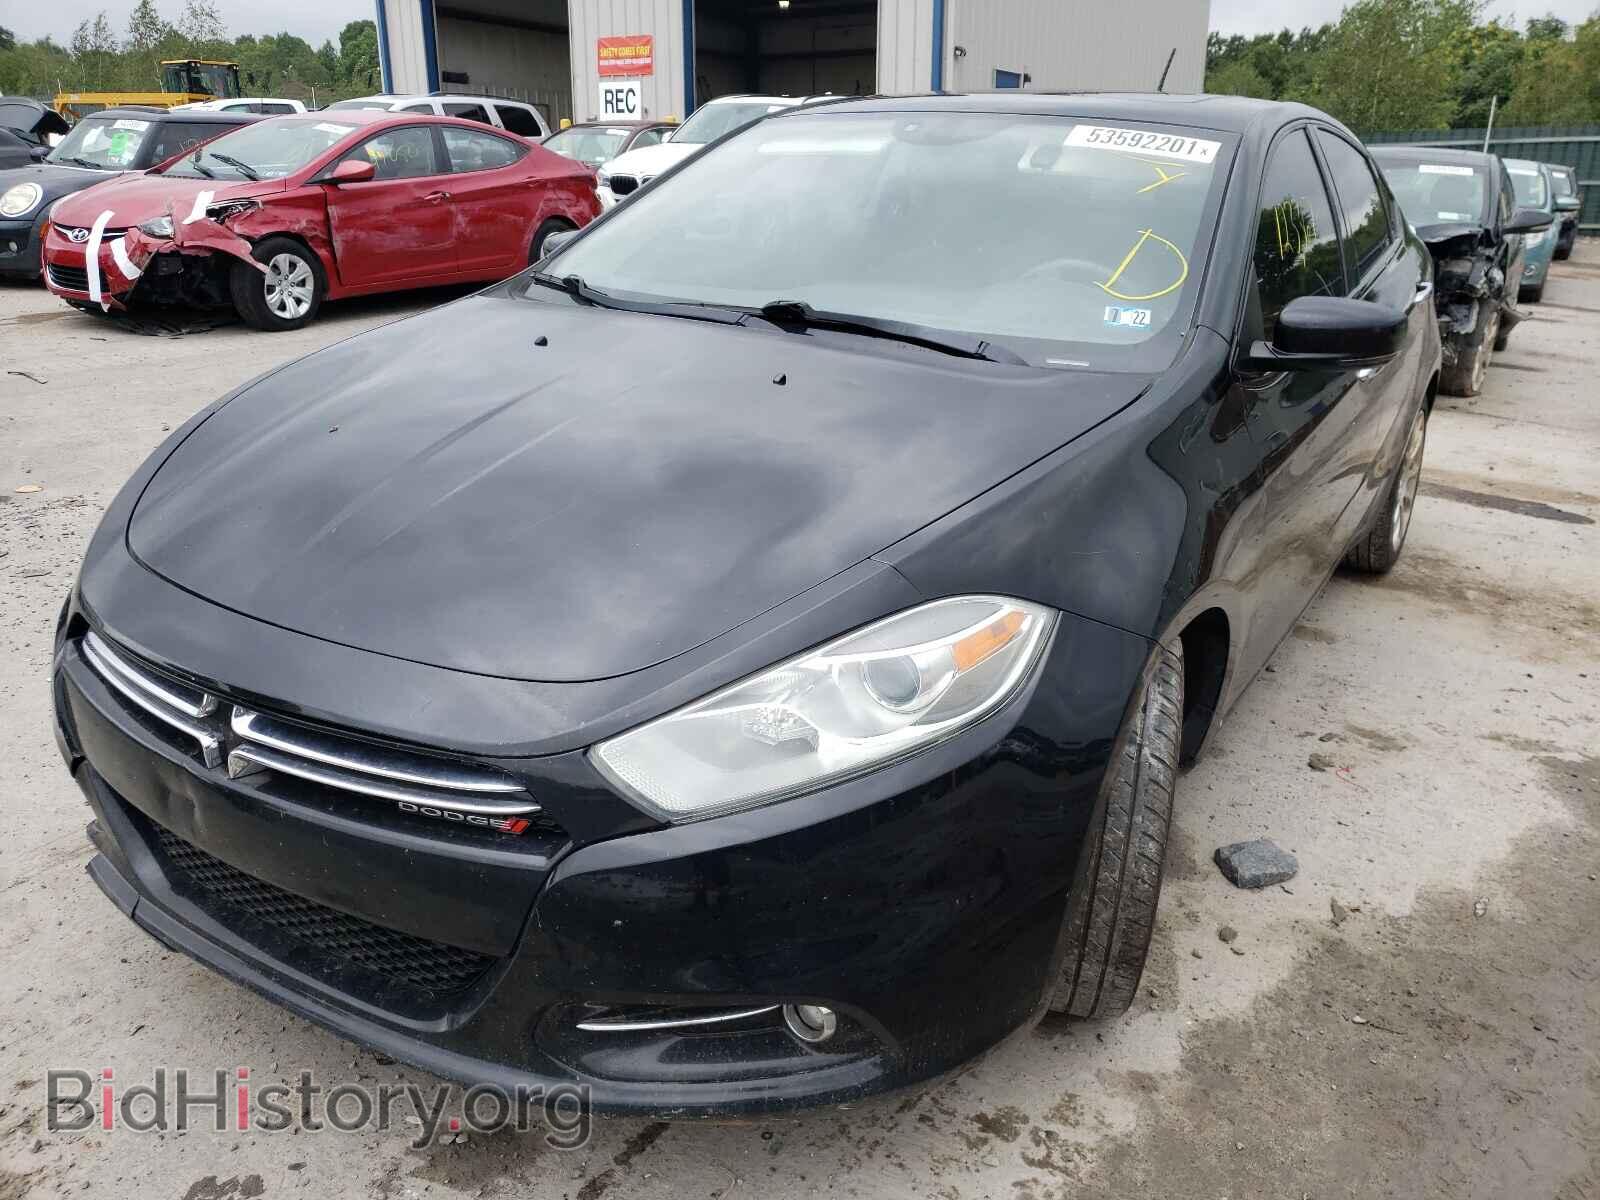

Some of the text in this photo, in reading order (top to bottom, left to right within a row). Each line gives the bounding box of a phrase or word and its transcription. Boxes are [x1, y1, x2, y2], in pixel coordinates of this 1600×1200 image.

[604, 88, 636, 113] REC
[1086, 128, 1198, 155] 53592201
[1132, 310, 1147, 325] 22
[398, 801, 512, 830] DODGE
